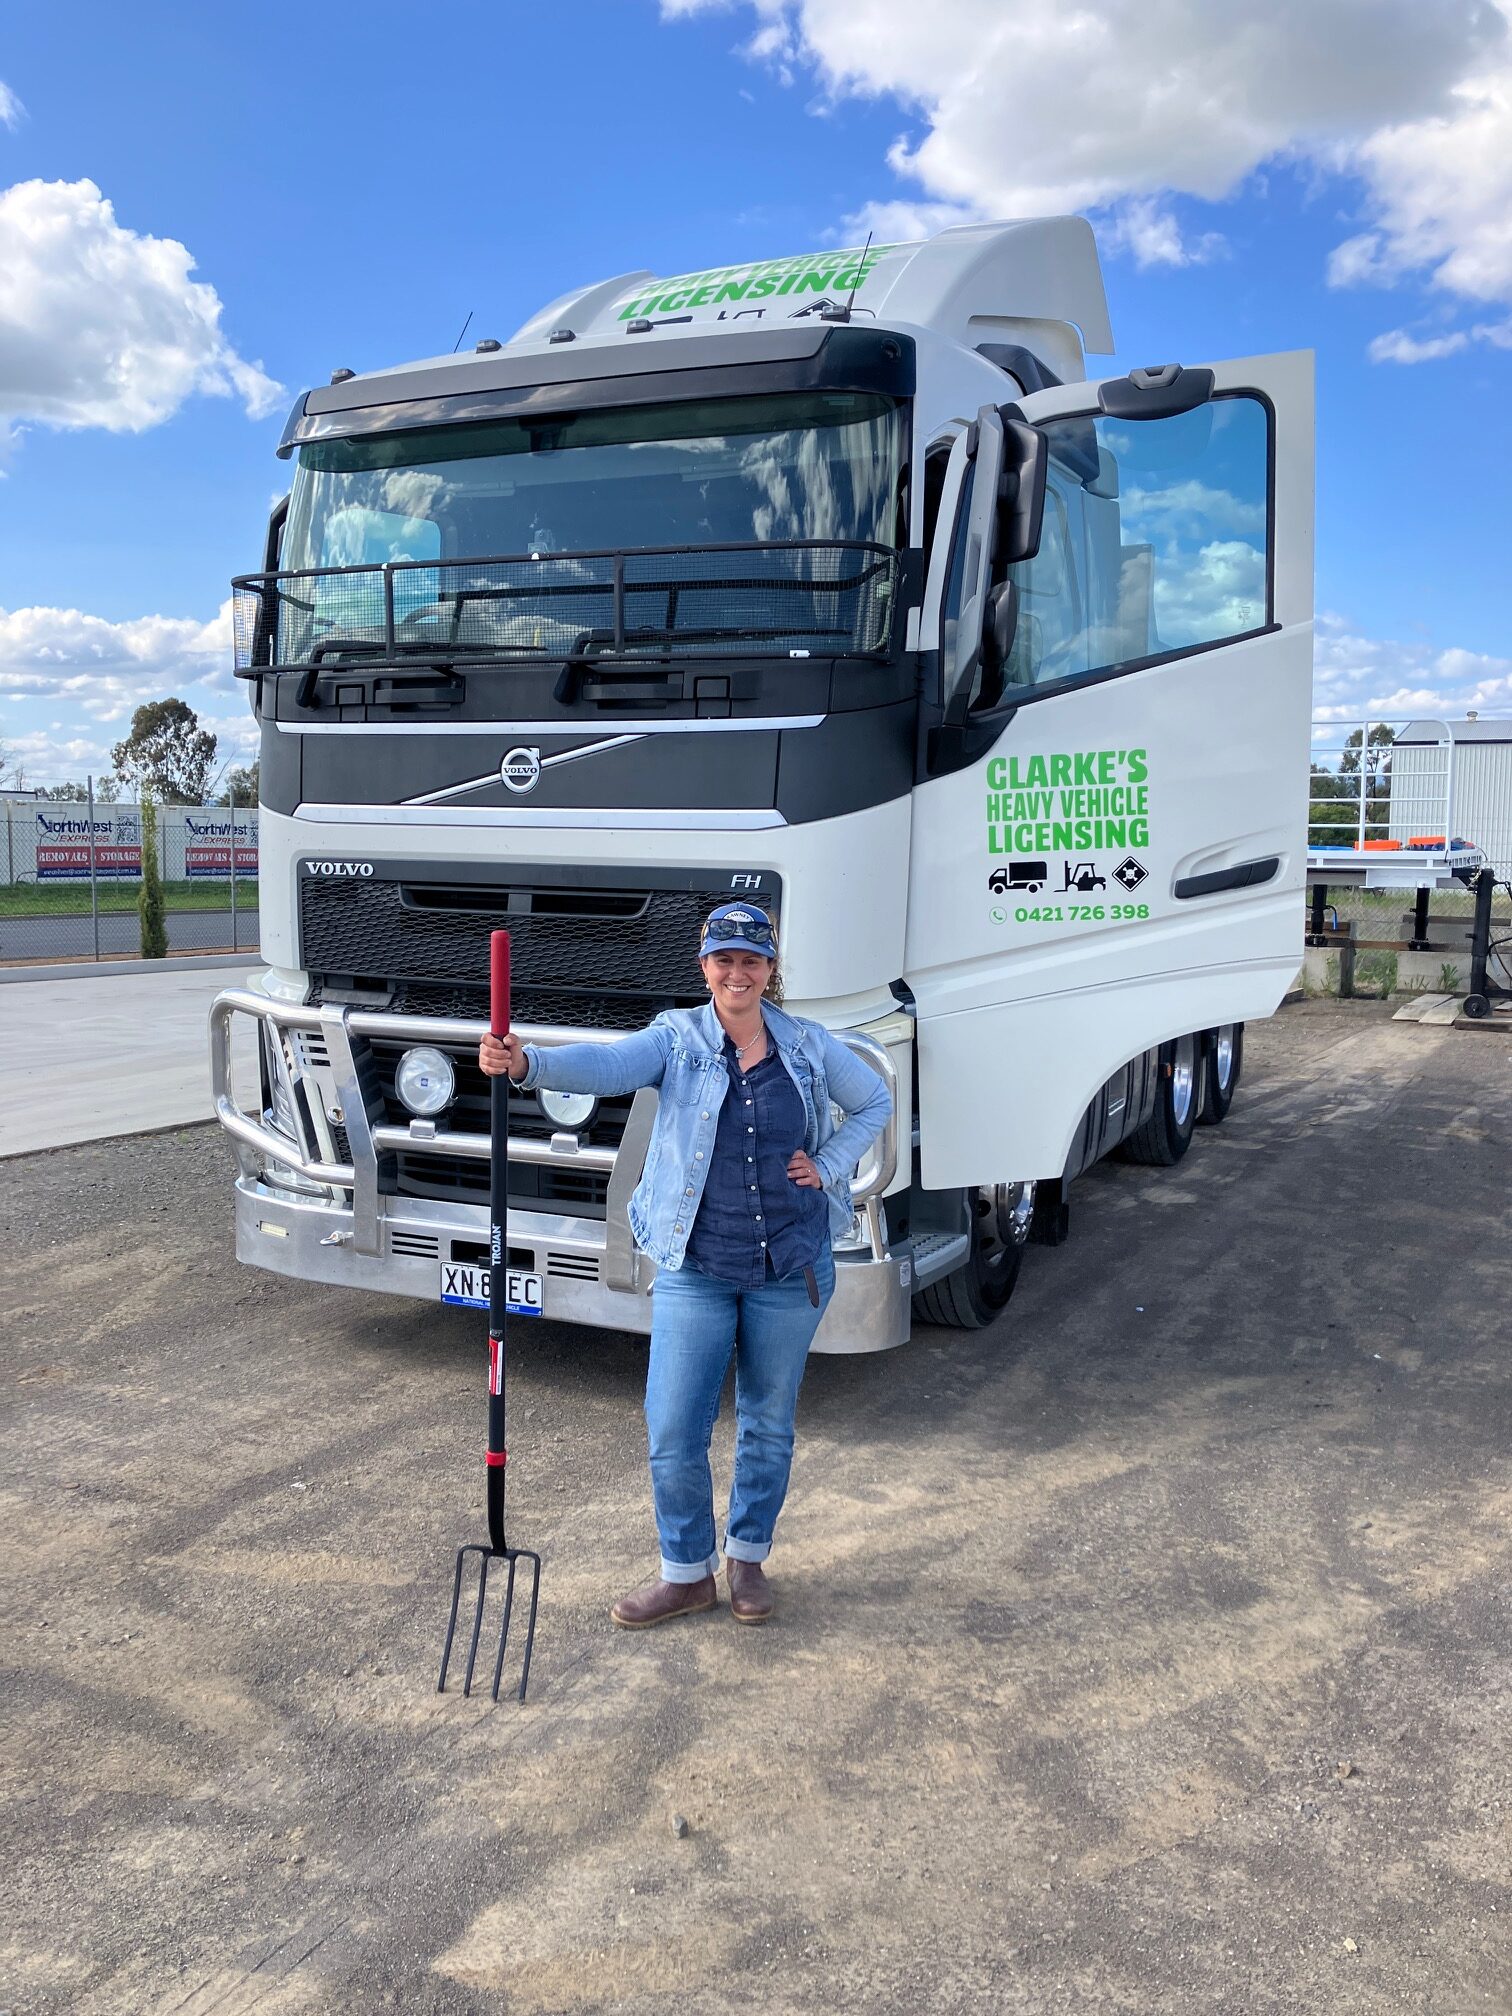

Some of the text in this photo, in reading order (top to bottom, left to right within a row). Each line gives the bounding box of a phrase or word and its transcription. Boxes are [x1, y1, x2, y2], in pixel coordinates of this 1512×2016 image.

[617, 268, 870, 321] LICENSING
[986, 749, 1149, 790] CLARKE'S
[986, 786, 1149, 823] HEAVY VEHICLE
[60, 834, 110, 842] EXPRSS
[987, 818, 1150, 854] LICENSING
[39, 852, 88, 862] REMOVALS
[100, 851, 140, 861] STORAGE
[305, 861, 374, 877] VOLVO
[730, 874, 762, 889] FH
[1015, 904, 1150, 923] 0421 726 398
[491, 1225, 502, 1267] TROJAN
